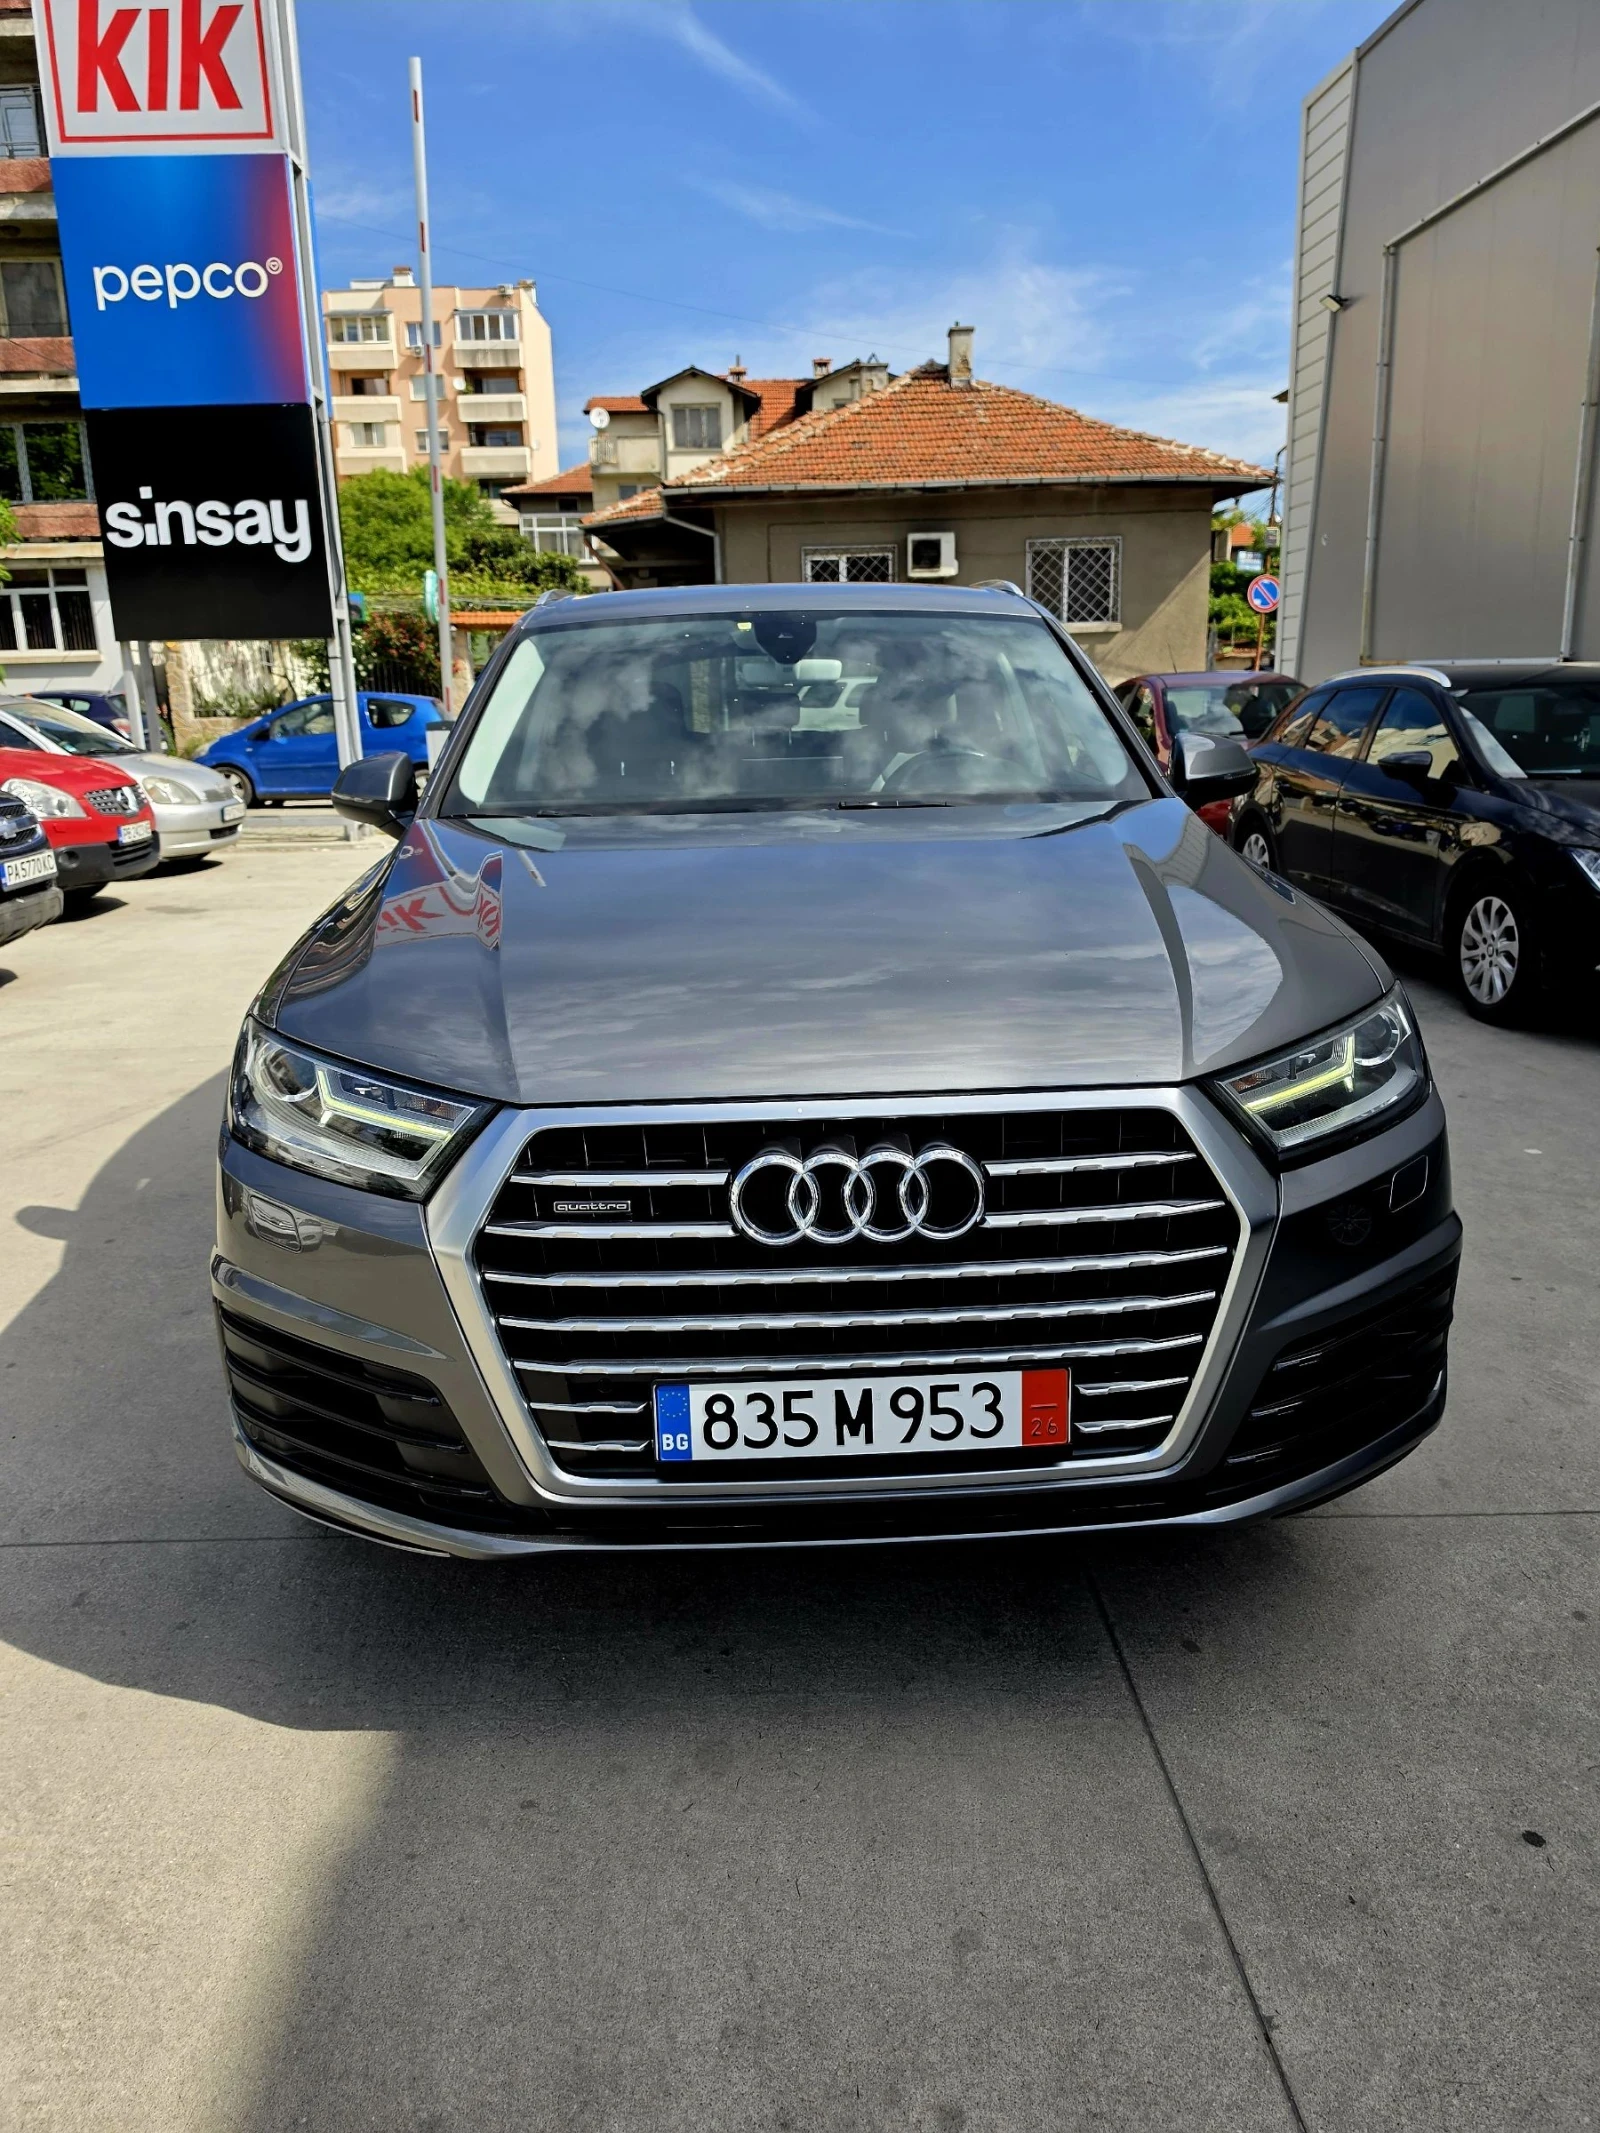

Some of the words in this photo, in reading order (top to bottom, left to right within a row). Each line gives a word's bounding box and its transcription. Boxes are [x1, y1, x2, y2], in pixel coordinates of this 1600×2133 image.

[92, 261, 269, 311] pepco
[105, 486, 312, 563] sinsay
[557, 1202, 627, 1212] quattro
[703, 1390, 819, 1450] 835
[834, 1388, 874, 1446] M
[889, 1381, 1004, 1443] 953
[1031, 1416, 1059, 1437] 26
[661, 1433, 689, 1451] BG
